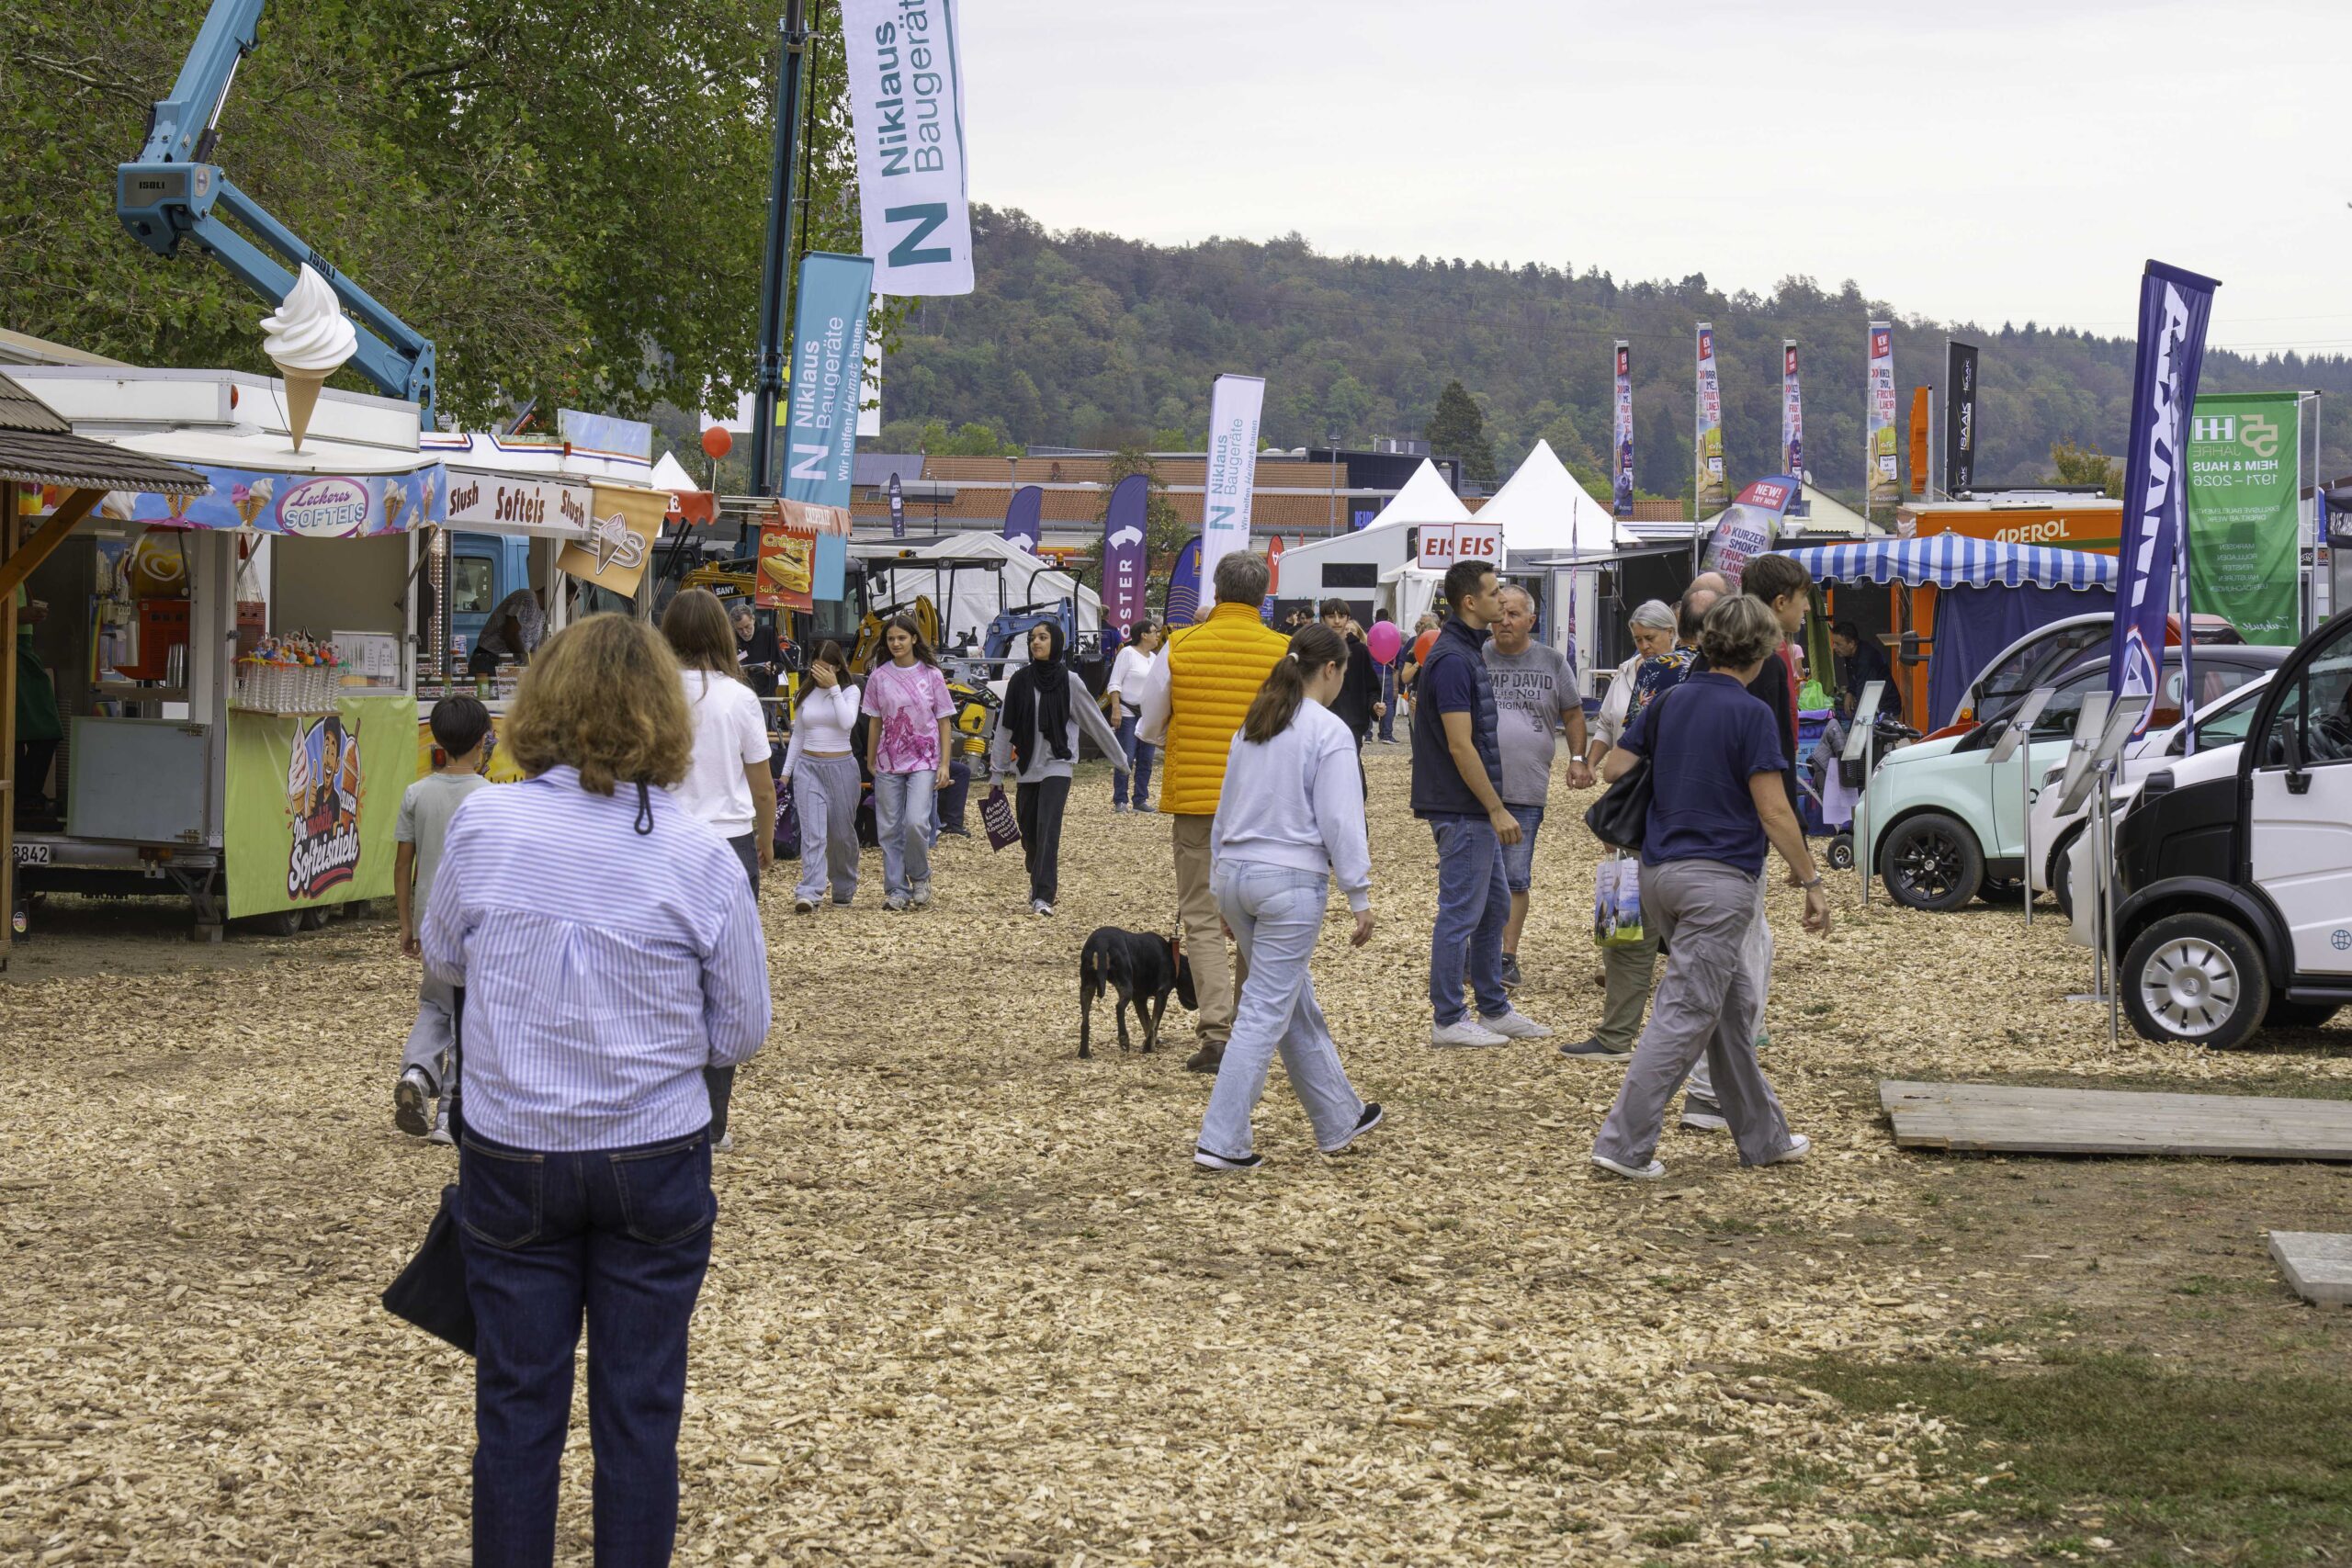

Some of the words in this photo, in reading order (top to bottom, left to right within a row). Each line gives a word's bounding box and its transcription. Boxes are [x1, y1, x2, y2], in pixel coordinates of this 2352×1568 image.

[876, 21, 910, 177] Niklaus
[139, 181, 165, 189] ISOLI
[885, 202, 952, 268] N
[309, 249, 336, 279] ISOLI
[849, 319, 864, 358] bauen
[795, 340, 820, 428] Niklaus
[816, 317, 843, 429] Baugeräte
[842, 363, 859, 414] Heimat
[840, 418, 854, 457] helfen
[1250, 419, 1258, 446] bauen
[1960, 402, 1969, 450] ISAAK
[790, 443, 830, 480] N
[1211, 434, 1227, 494] Niklaus
[1224, 418, 1243, 495] Baugeräte
[838, 460, 850, 481] Wir
[290, 486, 353, 507] Leckeres
[449, 480, 479, 516] Slush
[495, 486, 546, 525] Softeis
[560, 490, 584, 528] Slush
[1242, 487, 1251, 513] helfen
[1755, 484, 1782, 499] NEW!
[1763, 498, 1779, 506] NOW
[284, 503, 366, 529] SOFTEIS
[1209, 505, 1236, 530] N
[1240, 514, 1249, 531] Wir
[762, 533, 814, 551] Crêpes
[1731, 526, 1766, 546] KURZER
[1993, 518, 2070, 544] APEROL
[1459, 536, 1495, 556] EIS
[716, 586, 735, 596] SANY
[1118, 558, 1133, 639] ÖSTER
[1487, 673, 1509, 688] MP
[1512, 673, 1553, 690] DAVID
[2174, 676, 2181, 699] 1
[1497, 701, 1535, 710] RIGINAL
[340, 789, 356, 813] SLUSH
[294, 816, 308, 846] Die
[288, 822, 358, 892] Softeisdiele
